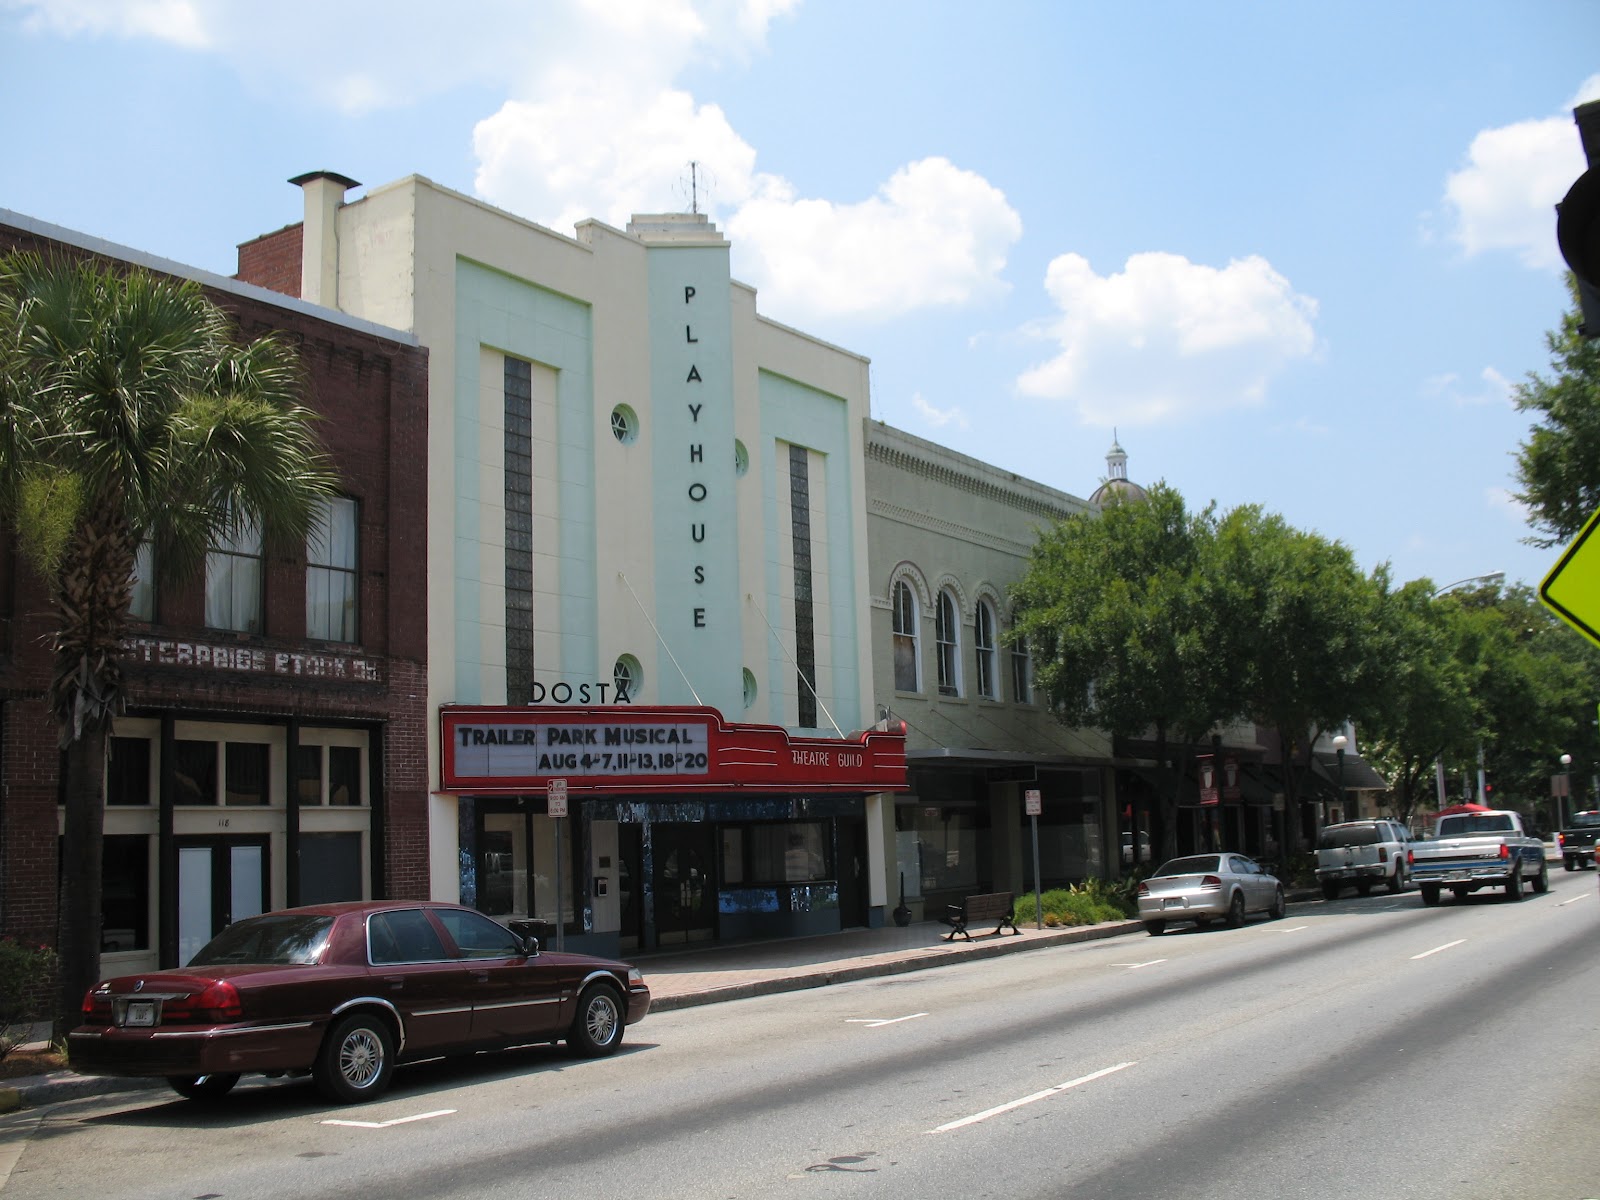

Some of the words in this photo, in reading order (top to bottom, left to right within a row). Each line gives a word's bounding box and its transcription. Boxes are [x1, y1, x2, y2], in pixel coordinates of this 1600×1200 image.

[684, 286, 708, 628] PLAYHOUSE
[530, 682, 631, 705] DOSTA
[458, 727, 536, 747] TRAILER
[547, 727, 597, 747] PARK
[604, 728, 693, 747] MUSICAL
[538, 753, 577, 770] AUG
[791, 750, 830, 767] THEATRE
[838, 753, 863, 768] GUILD
